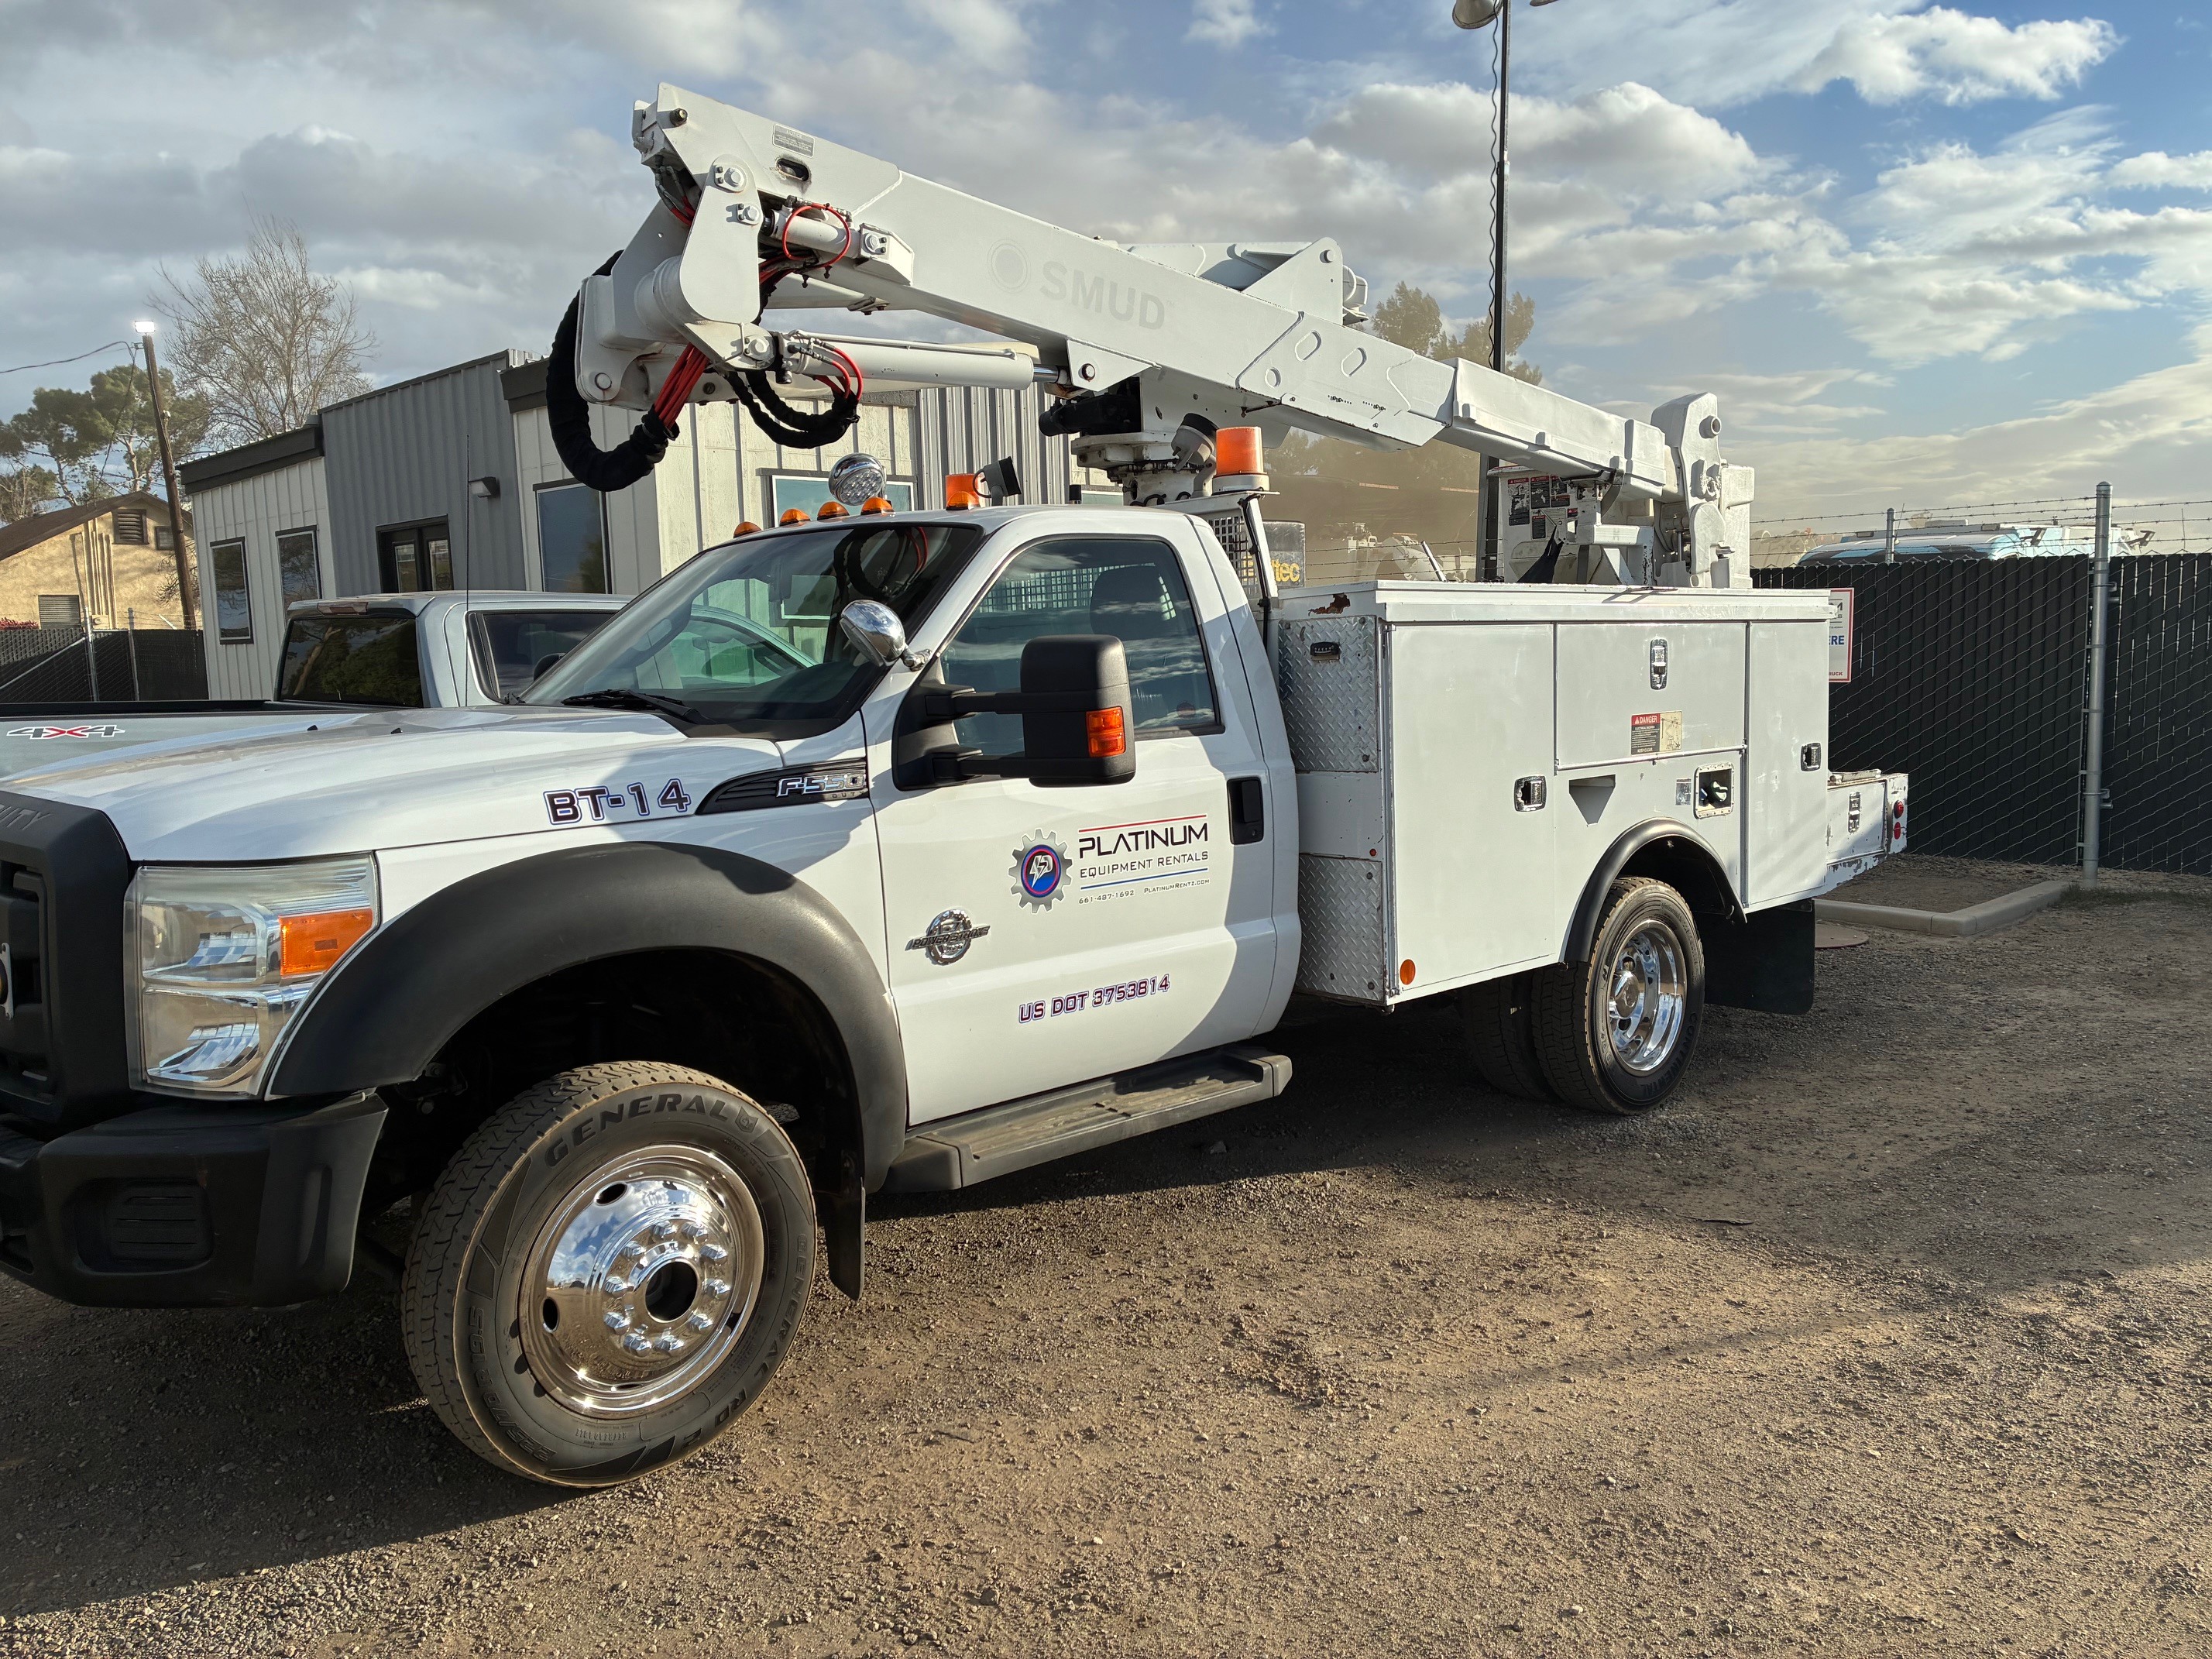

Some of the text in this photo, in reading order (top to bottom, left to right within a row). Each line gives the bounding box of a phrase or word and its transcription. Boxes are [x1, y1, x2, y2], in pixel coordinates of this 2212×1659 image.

[1039, 261, 1165, 330] SMUD
[1639, 715, 1657, 723] DANGER
[543, 778, 692, 825] BT-14
[1079, 823, 1208, 859] PLATINUM
[1080, 851, 1209, 878] EQUIPMENT RENTALS
[1018, 974, 1170, 1023] US DOT 3753814
[545, 1093, 729, 1168] GENERAL
[754, 1234, 807, 1378] GENERAL
